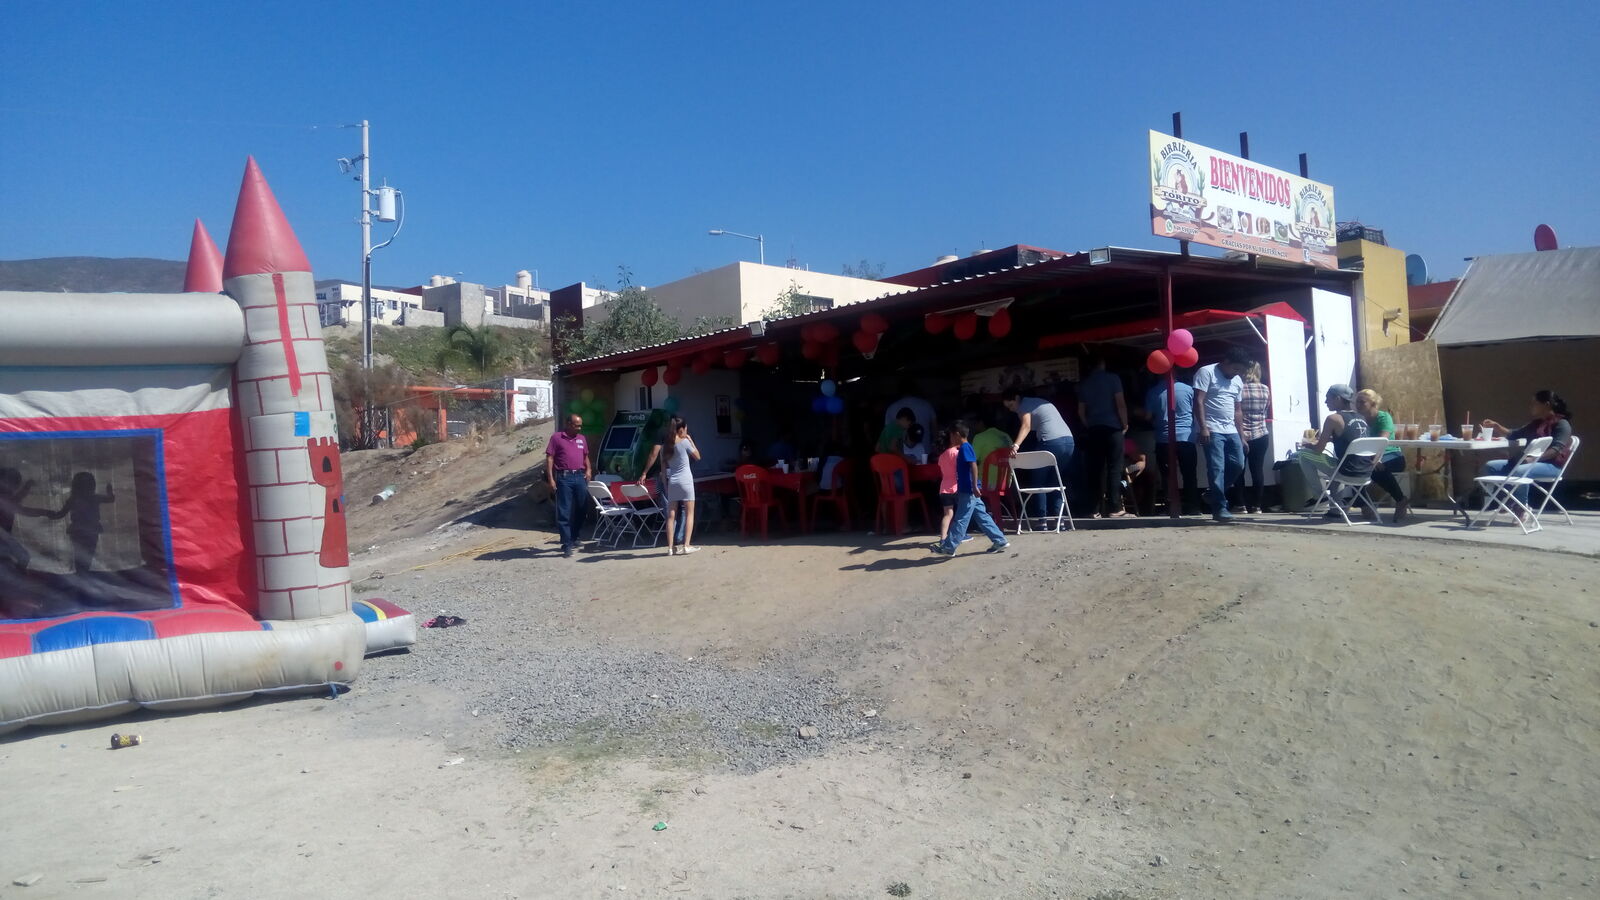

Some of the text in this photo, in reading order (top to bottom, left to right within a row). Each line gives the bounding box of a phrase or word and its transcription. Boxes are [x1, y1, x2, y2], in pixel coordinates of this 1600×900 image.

[1160, 141, 1198, 170] BIRRIERIA
[1209, 155, 1291, 208] BIENVENIDOS
[1161, 190, 1200, 205] TORITO
[1299, 183, 1327, 207] BIRRIERIA
[1300, 225, 1329, 237] TORITO
